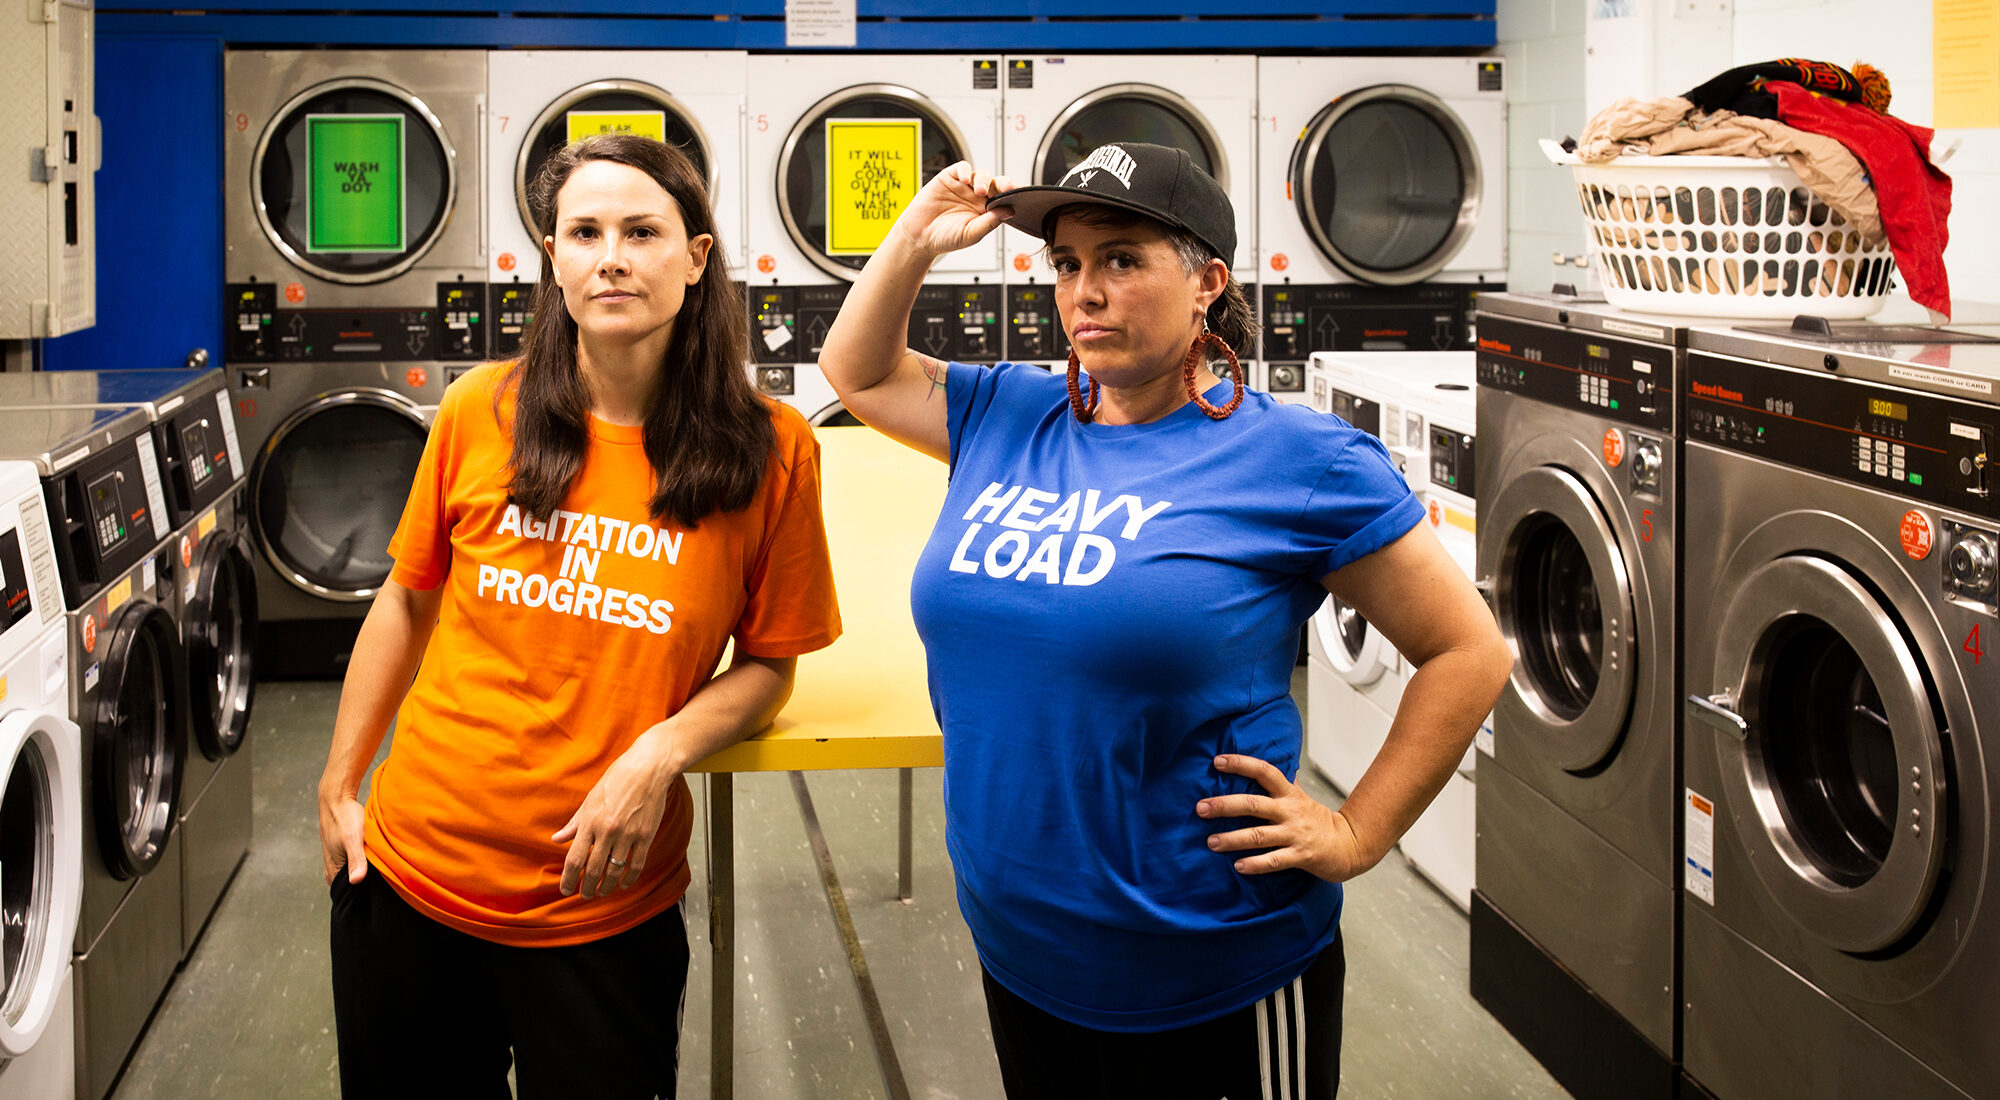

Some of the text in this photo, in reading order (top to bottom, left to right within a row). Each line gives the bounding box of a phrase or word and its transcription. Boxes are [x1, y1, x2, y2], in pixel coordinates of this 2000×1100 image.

[236, 113, 249, 132] 9
[498, 115, 510, 134] 7
[757, 114, 769, 132] 5
[1015, 114, 1026, 131] 3
[1269, 115, 1277, 132] 1
[849, 150, 903, 160] IT WILL
[334, 162, 379, 173] WASH
[863, 160, 888, 170] ALL
[348, 170, 367, 182] YA
[855, 170, 897, 180] COME
[342, 182, 372, 193] DOT
[850, 180, 901, 192] OUT IN
[863, 190, 890, 200] THE
[855, 200, 897, 210] WASH
[862, 210, 891, 220] BUB
[1692, 380, 1743, 402] Speed Queen
[1932, 376, 1955, 385] COINS
[1965, 381, 1987, 390] CARD
[236, 398, 257, 418] 10
[1873, 400, 1892, 416] 9.00
[962, 481, 1173, 541] HEAVY
[1641, 509, 1653, 542] 5
[496, 504, 684, 565] AGITATION
[949, 522, 1116, 587] LOAD
[559, 544, 601, 583] IN
[477, 564, 675, 635] PROGRESS
[1963, 623, 1983, 665] 4
